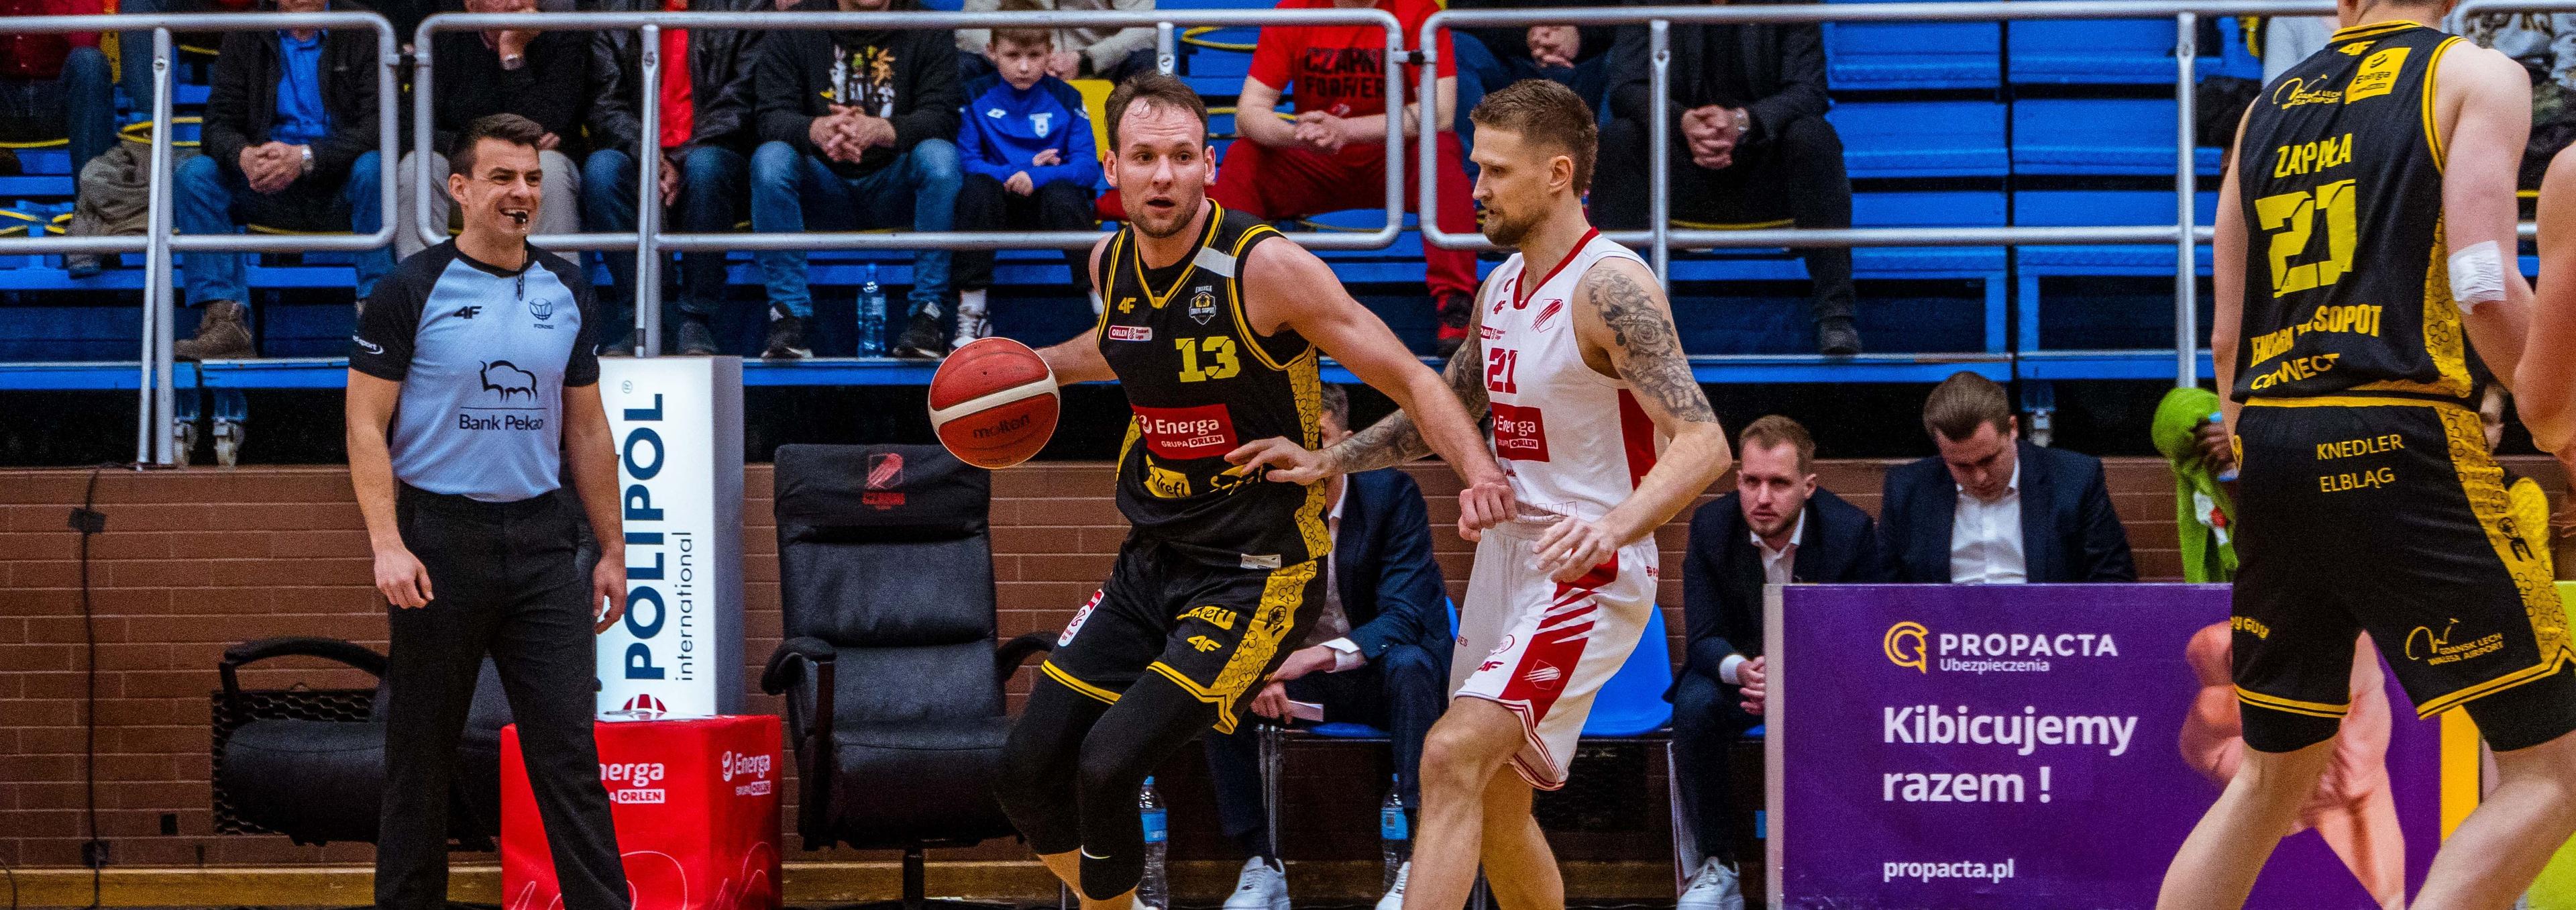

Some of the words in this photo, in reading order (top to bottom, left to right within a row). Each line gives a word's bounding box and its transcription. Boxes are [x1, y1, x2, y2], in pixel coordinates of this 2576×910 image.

[2255, 179, 2358, 299] 21
[453, 305, 482, 319] 4F
[1118, 297, 1137, 314] 4F
[2314, 303, 2383, 338] SOPOT
[1175, 336, 1241, 383] 13
[1487, 348, 1518, 394] 21
[460, 413, 501, 430] Bank
[505, 415, 544, 430] Pekao
[973, 413, 1030, 439] molten
[1155, 419, 1220, 436] Energa
[1190, 436, 1224, 446] ORLEN
[1510, 440, 1538, 448] ORLEN
[2316, 434, 2405, 460] KNEDLER
[1157, 472, 1186, 498] Trefl
[2319, 467, 2396, 493] ELBLĄG
[623, 394, 664, 680] POLIPOL
[672, 532, 692, 680] international
[1187, 635, 1222, 653] 4F
[1939, 633, 2118, 657] PROPACTA
[1939, 658, 2050, 675] Ubezpieczenia
[1884, 705, 2139, 756] Kibicujemy
[599, 762, 665, 787] nerga
[735, 753, 771, 779] Energa
[620, 791, 661, 801] ORLEN
[1884, 772, 2025, 803] razem
[2039, 766, 2051, 803] !
[1884, 858, 2015, 884] propacta.pl
